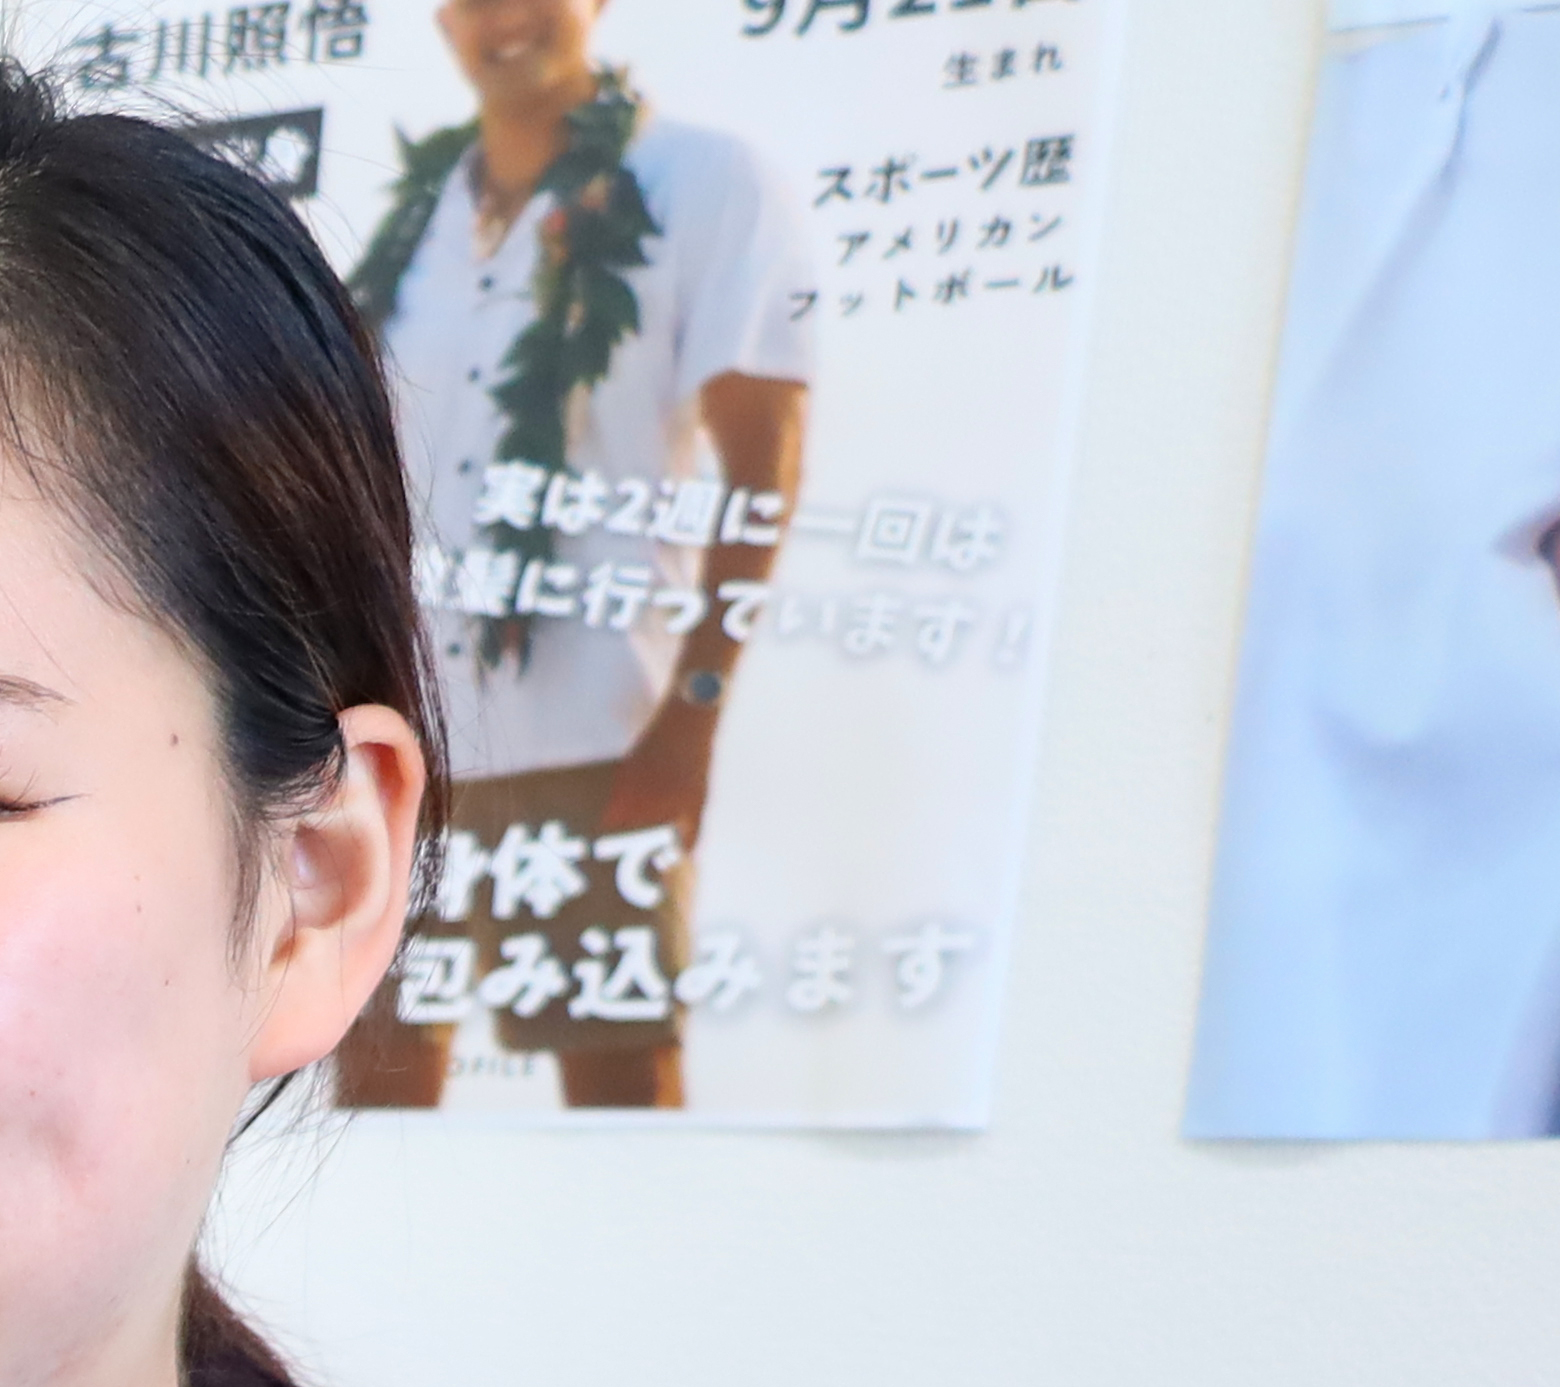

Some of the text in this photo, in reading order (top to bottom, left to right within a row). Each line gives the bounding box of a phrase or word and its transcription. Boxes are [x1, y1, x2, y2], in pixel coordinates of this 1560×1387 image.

[942, 41, 1065, 89] 生まれ
[814, 133, 1078, 207] スポーツ歴
[836, 211, 1064, 266] アメリカン
[787, 264, 1077, 323] フットボール
[475, 459, 1004, 571] 実は2週に一回は
[395, 922, 975, 1026] 包み込みます
